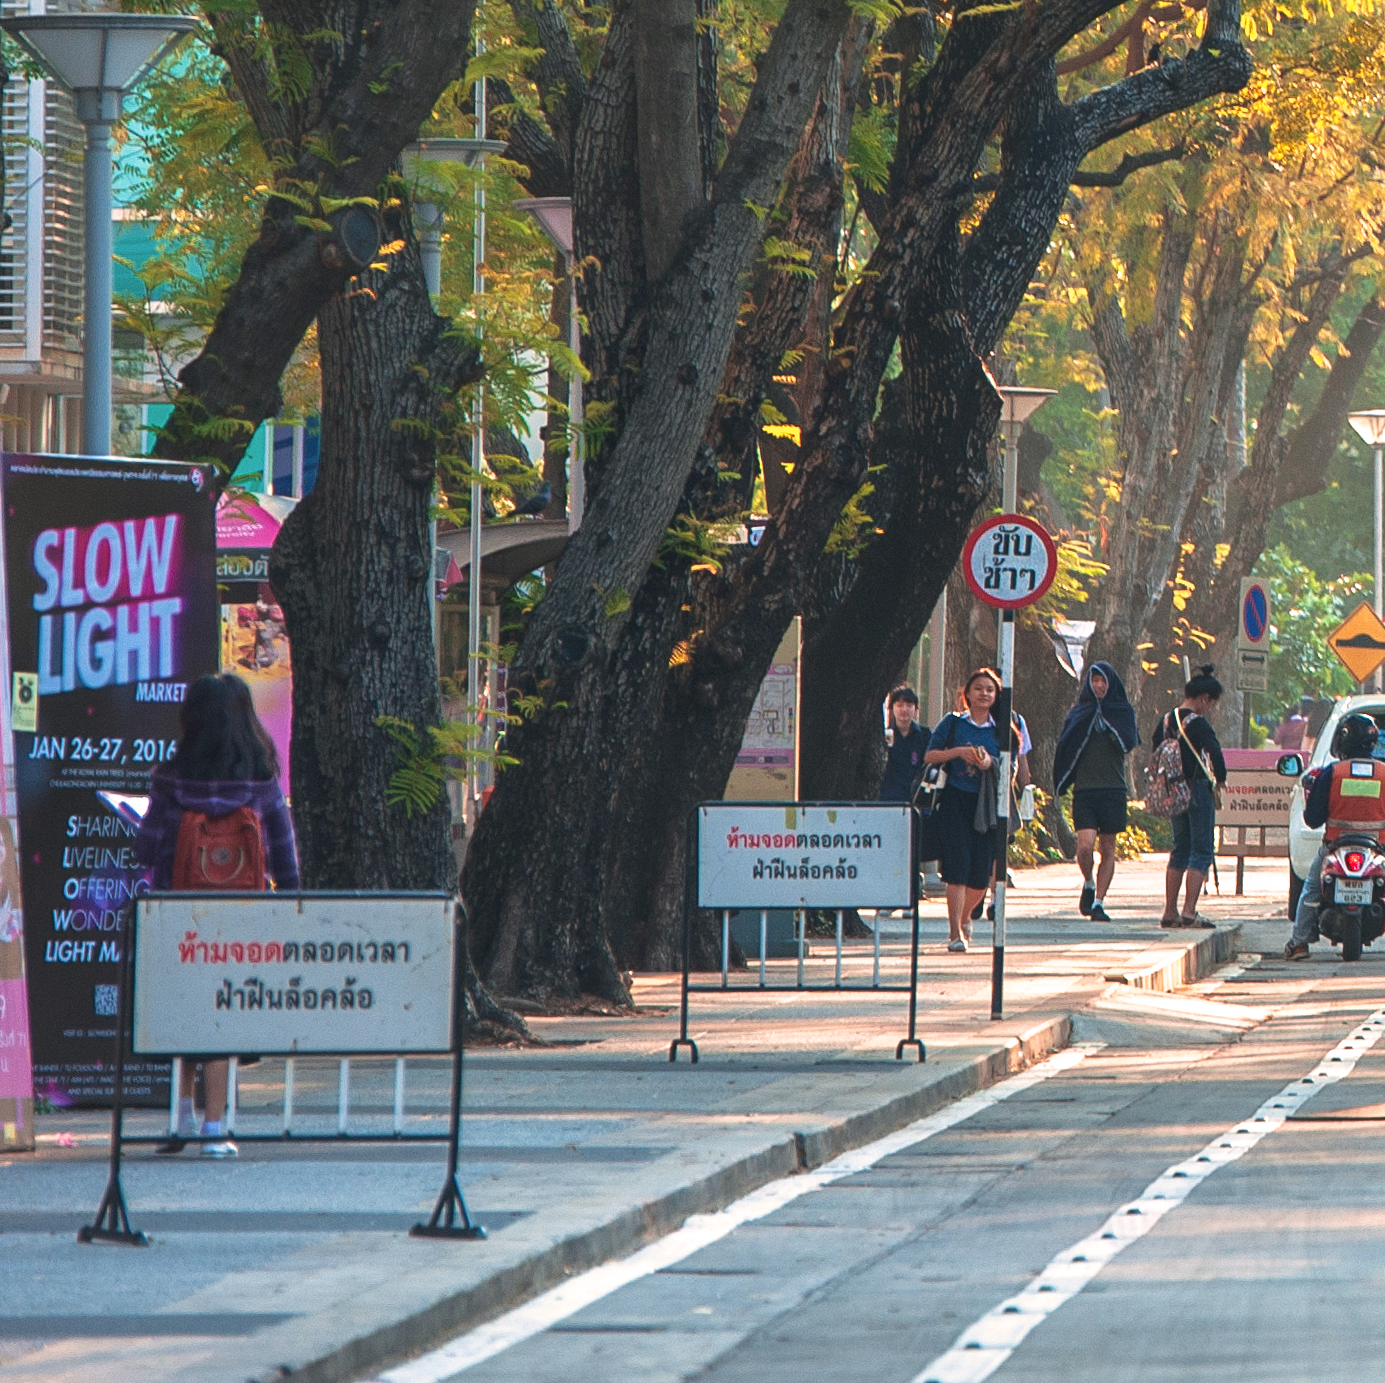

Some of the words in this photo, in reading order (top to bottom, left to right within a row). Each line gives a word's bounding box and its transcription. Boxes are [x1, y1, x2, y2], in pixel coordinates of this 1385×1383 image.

[992, 525, 1033, 556] ขับ
[33, 514, 180, 612] SLOW
[983, 557, 1036, 591] ช้าๆ
[37, 597, 182, 696] LIGHT
[135, 682, 187, 702] MARKET
[28, 736, 66, 760] JAN
[70, 737, 127, 765] 26-27,
[132, 738, 177, 762] 2016
[726, 826, 882, 849] ห้ามจอดตลอดเวลา
[752, 855, 859, 880] ฝ่าฝืนล็อคล้อ
[63, 878, 151, 900] OFFERING
[52, 909, 125, 932] WONDE
[44, 940, 96, 963] LIGHT
[177, 930, 411, 964] ห้ามจอดตลอดเวลา
[214, 975, 374, 1011] ฝ่าฝืนล็อคล้อ
